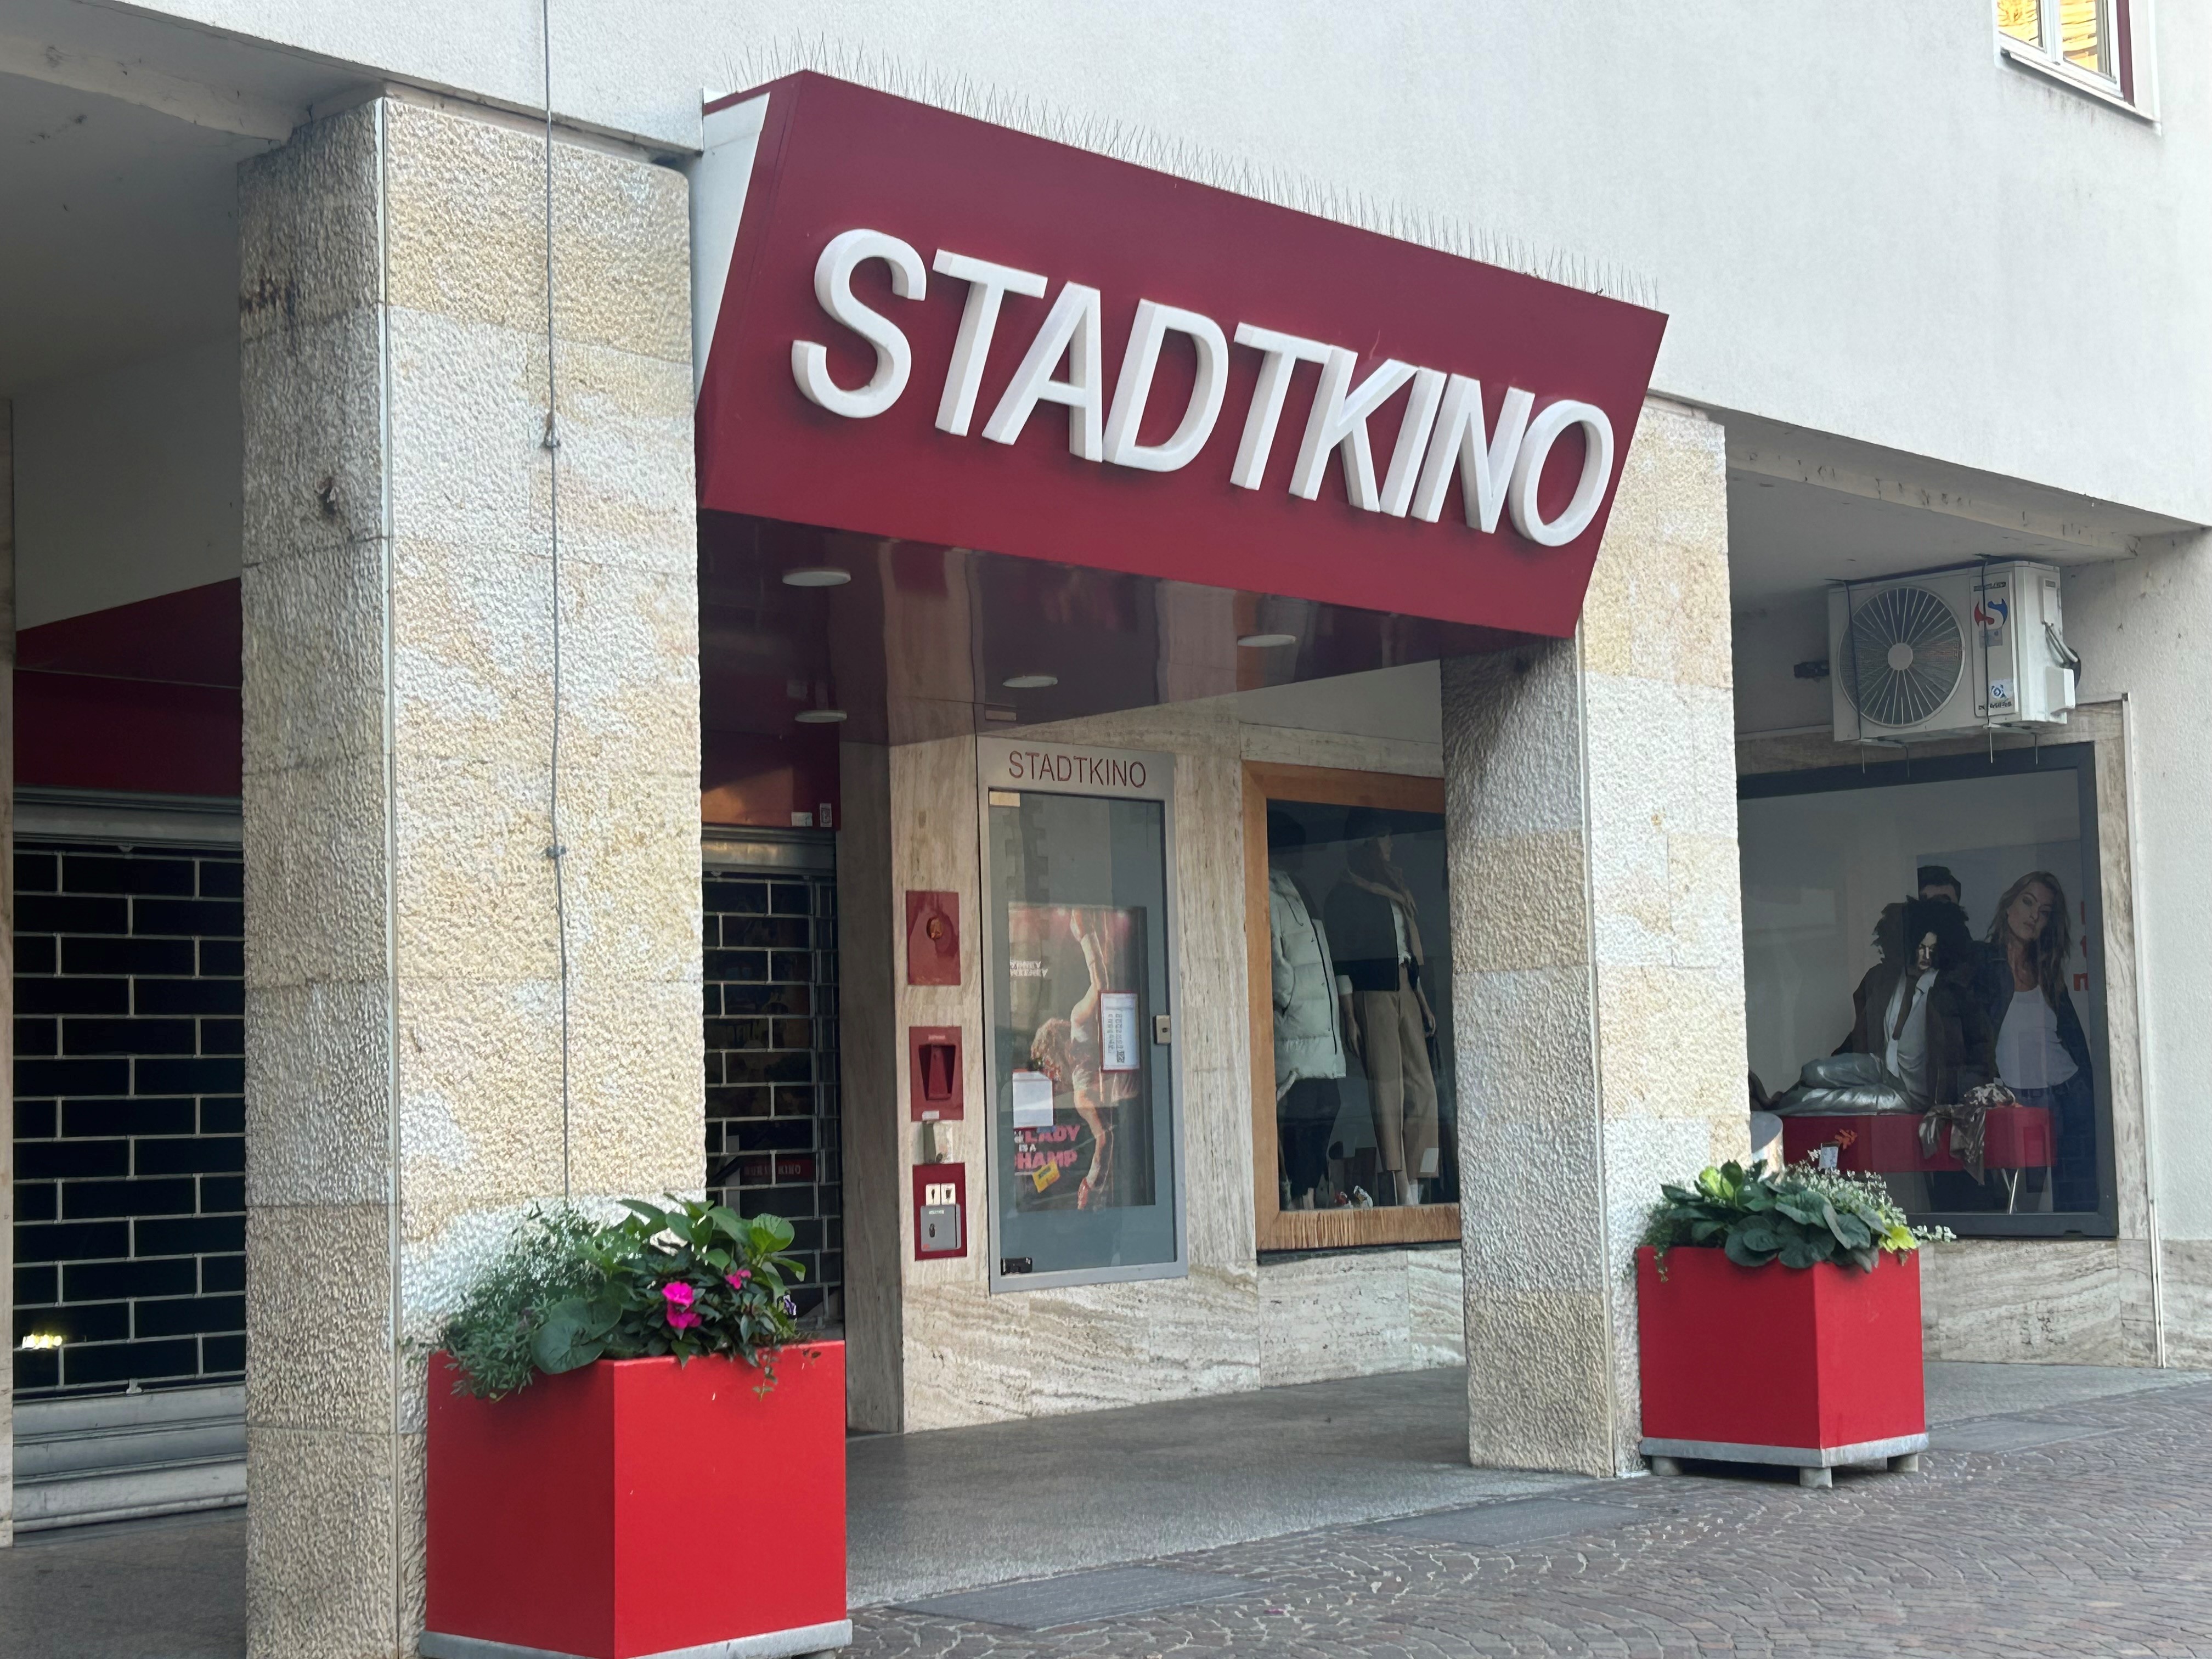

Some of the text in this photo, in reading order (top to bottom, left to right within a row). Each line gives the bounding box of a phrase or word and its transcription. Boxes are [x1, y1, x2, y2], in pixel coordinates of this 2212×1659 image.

[792, 228, 1615, 547] STADTKINO
[1009, 750, 1146, 788] STADTKINO
[778, 1164, 801, 1175] KINO
[1014, 1150, 1077, 1169] HAMP
